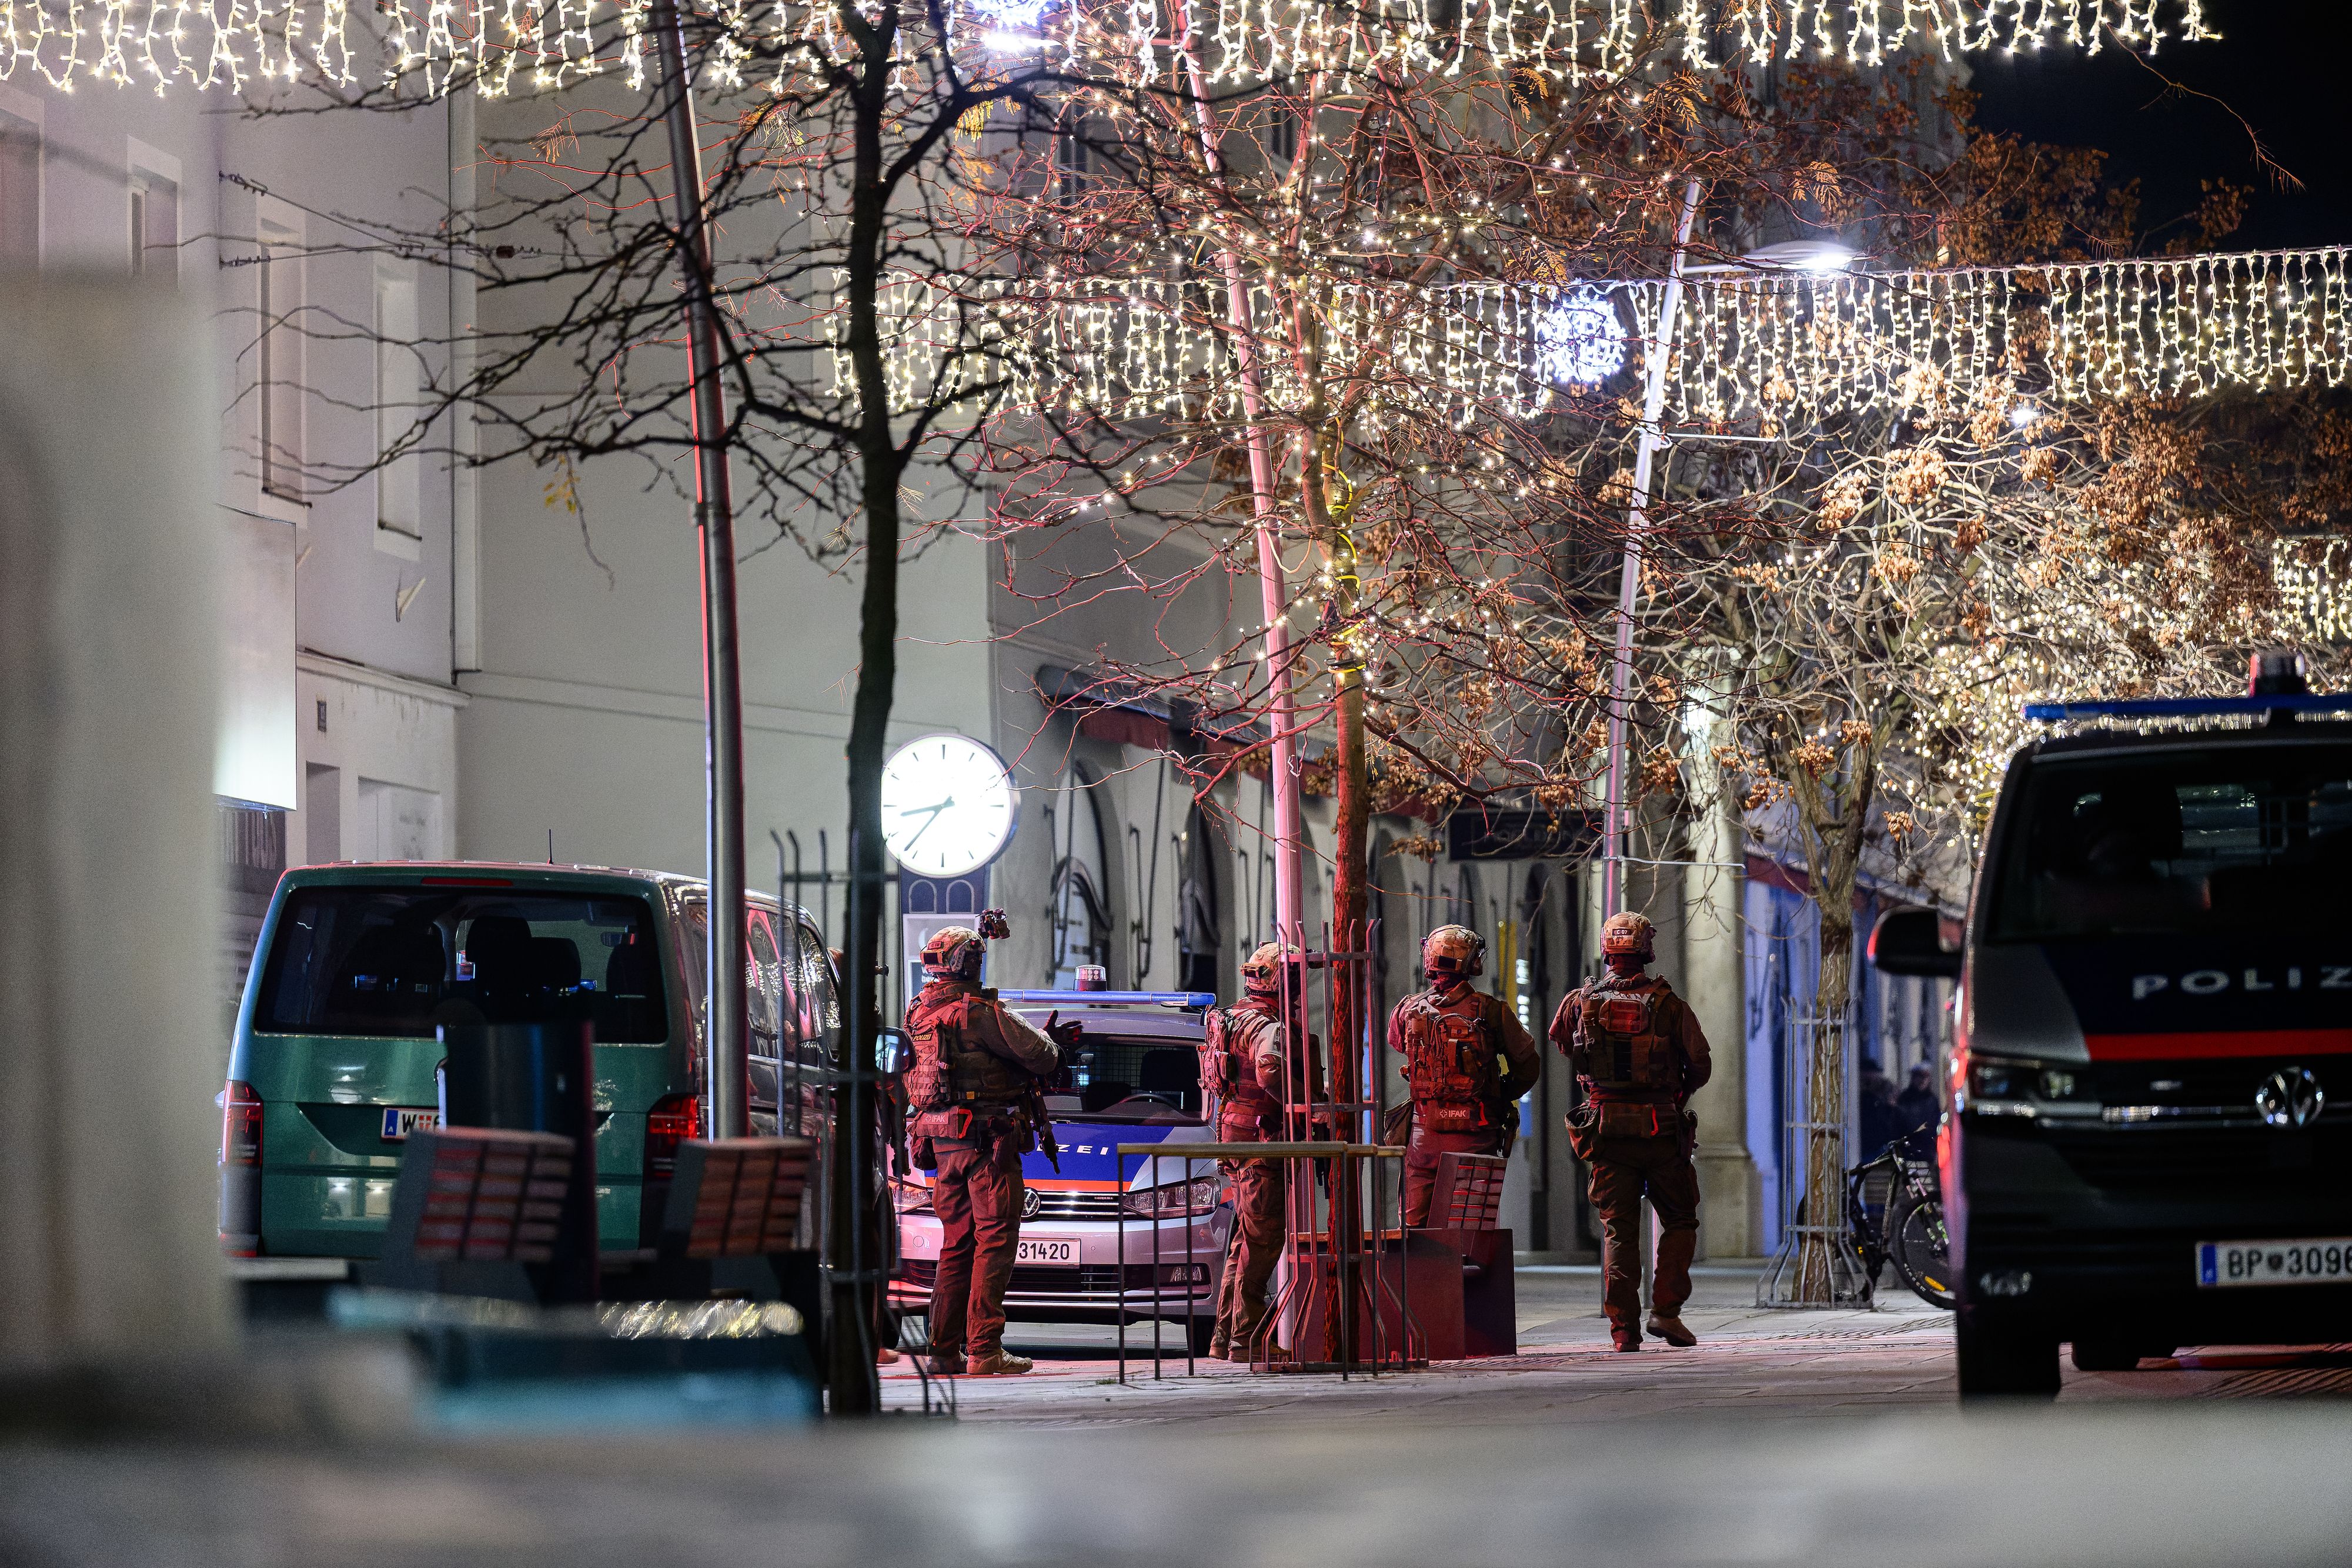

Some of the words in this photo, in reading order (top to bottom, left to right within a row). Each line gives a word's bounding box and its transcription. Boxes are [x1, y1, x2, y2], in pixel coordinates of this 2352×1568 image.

[2132, 966, 2352, 999] POLIZ
[402, 1114, 417, 1134] W
[1018, 1242, 1070, 1260] 31420
[2228, 1249, 2263, 1278] BP
